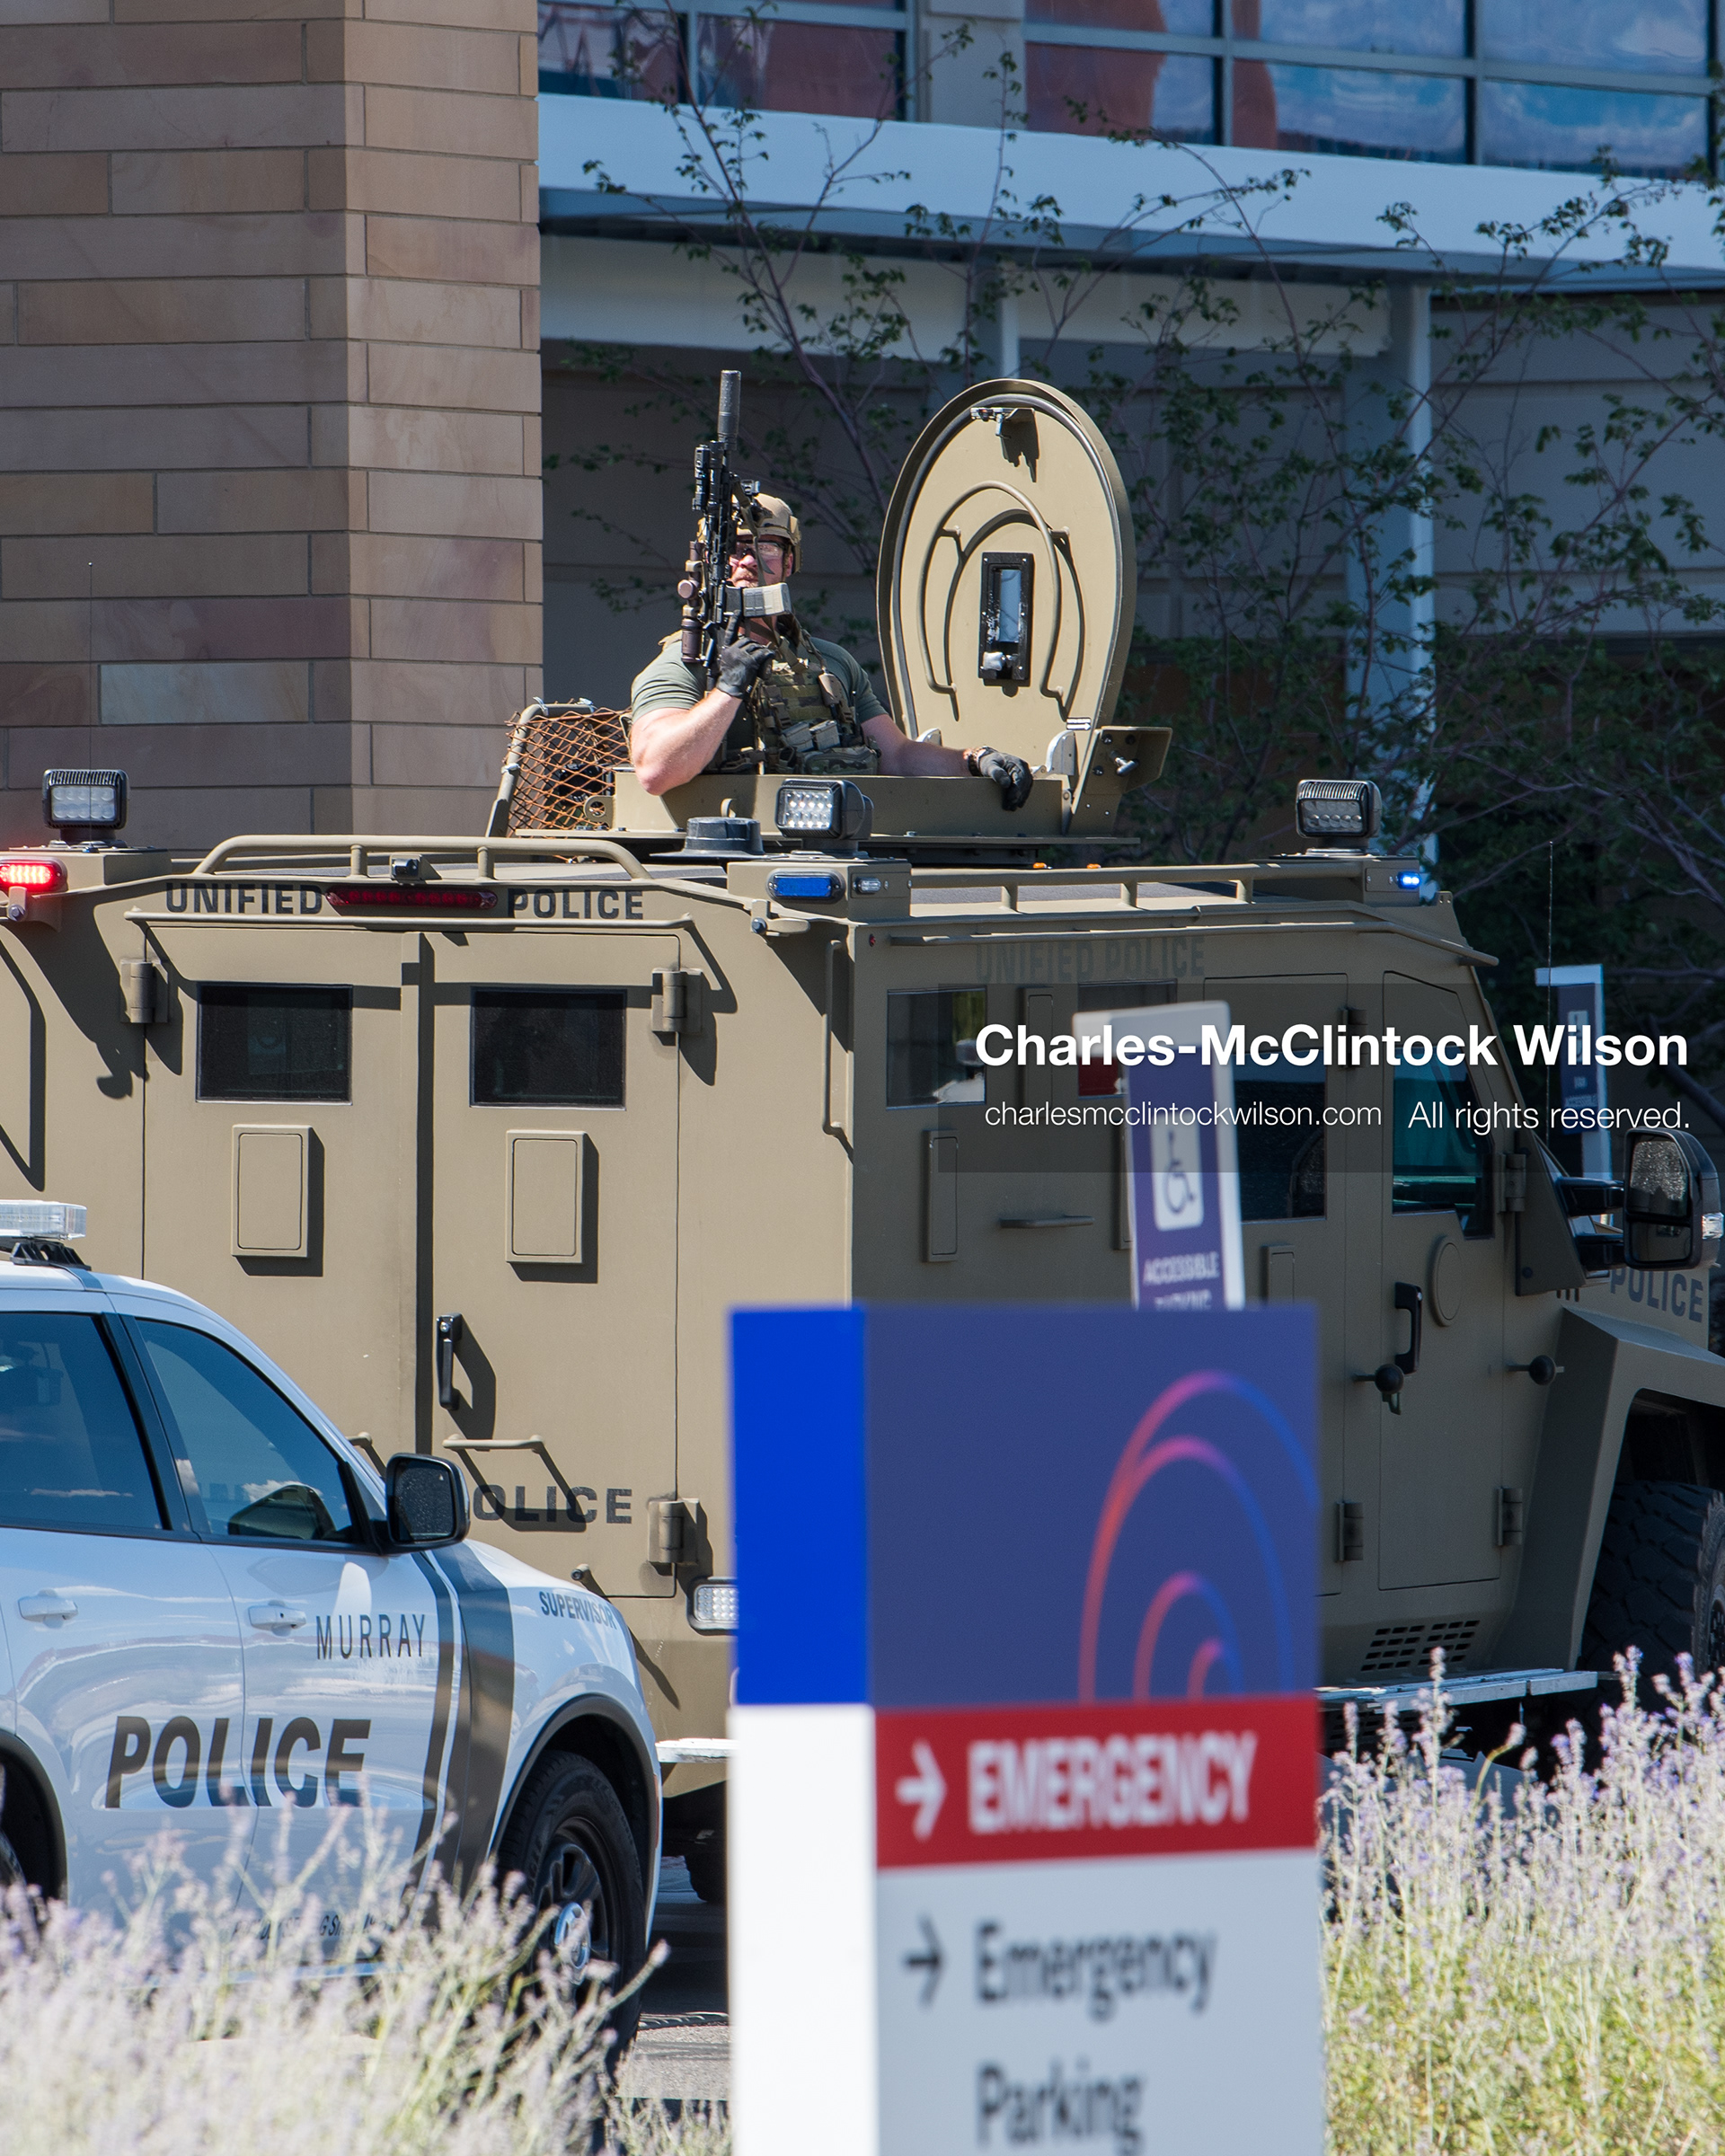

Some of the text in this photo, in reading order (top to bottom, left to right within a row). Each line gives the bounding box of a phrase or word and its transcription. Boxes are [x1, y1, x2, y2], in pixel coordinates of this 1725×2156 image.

[165, 881, 644, 920] UNIFIED POLICE
[976, 936, 1205, 984] UNIFIED POLICE
[1610, 1268, 1704, 1323] POLICE
[473, 1484, 632, 1524] OLICE
[539, 1591, 617, 1630] SUPERVISOR
[315, 1613, 426, 1660] MURRAY
[105, 1715, 372, 1808] POLICE
[969, 1730, 1256, 1834] EMERGENCY
[975, 1918, 1216, 2023] Emergency
[976, 2057, 1144, 2156] Parking
